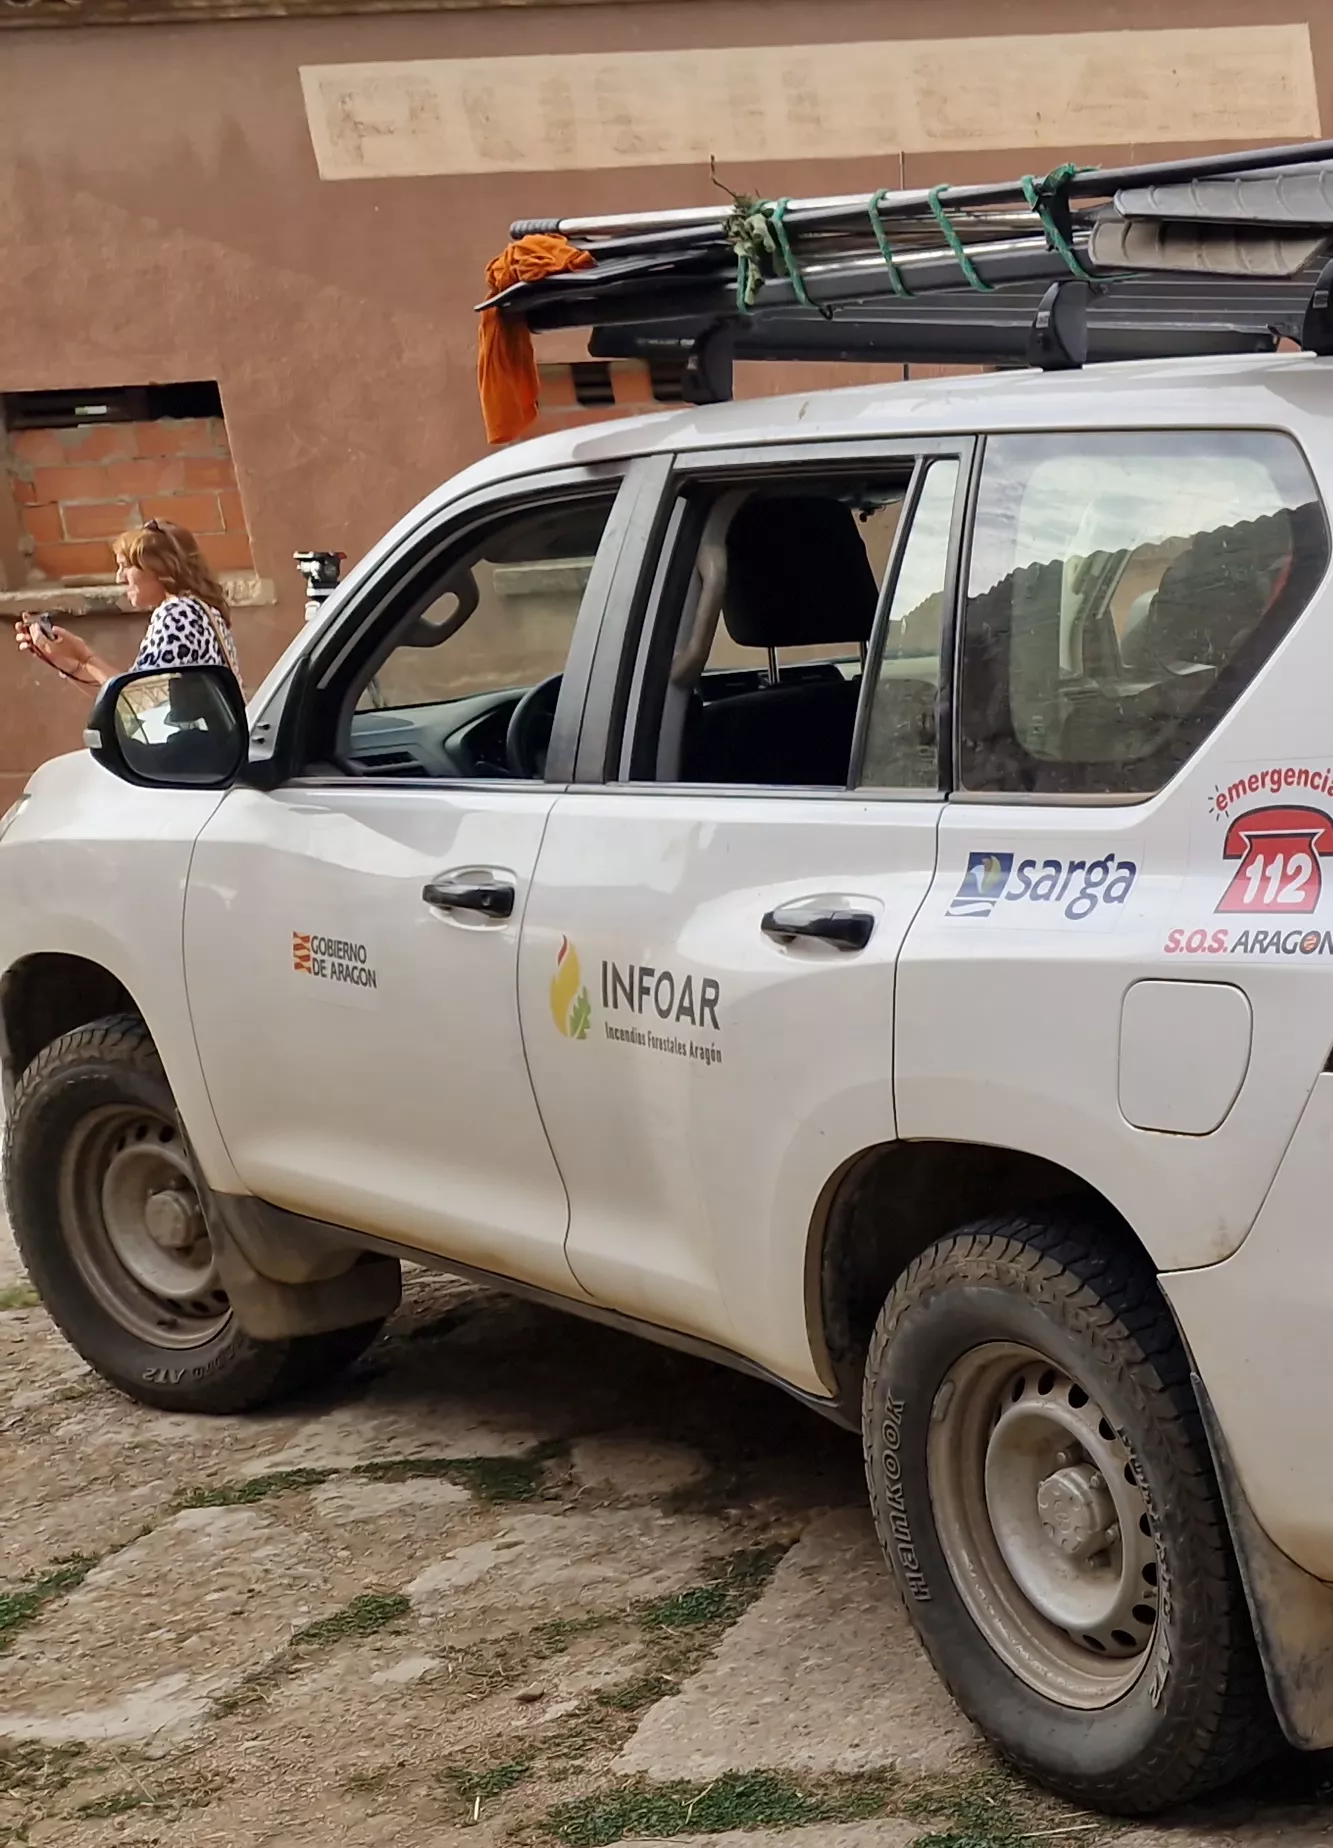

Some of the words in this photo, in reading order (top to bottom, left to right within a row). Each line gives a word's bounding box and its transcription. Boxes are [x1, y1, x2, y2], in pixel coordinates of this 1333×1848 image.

[1006, 852, 1138, 920] sarga
[1243, 852, 1313, 904] 112
[311, 936, 366, 964] GOBIERNO
[1163, 929, 1228, 954] S.O.S.
[313, 958, 327, 978] DE
[330, 962, 377, 989] ARAGON
[602, 960, 722, 1031] INFOAR
[605, 1021, 645, 1046] Incendios
[648, 1031, 687, 1056] Forestales
[689, 1039, 723, 1067] Aragón
